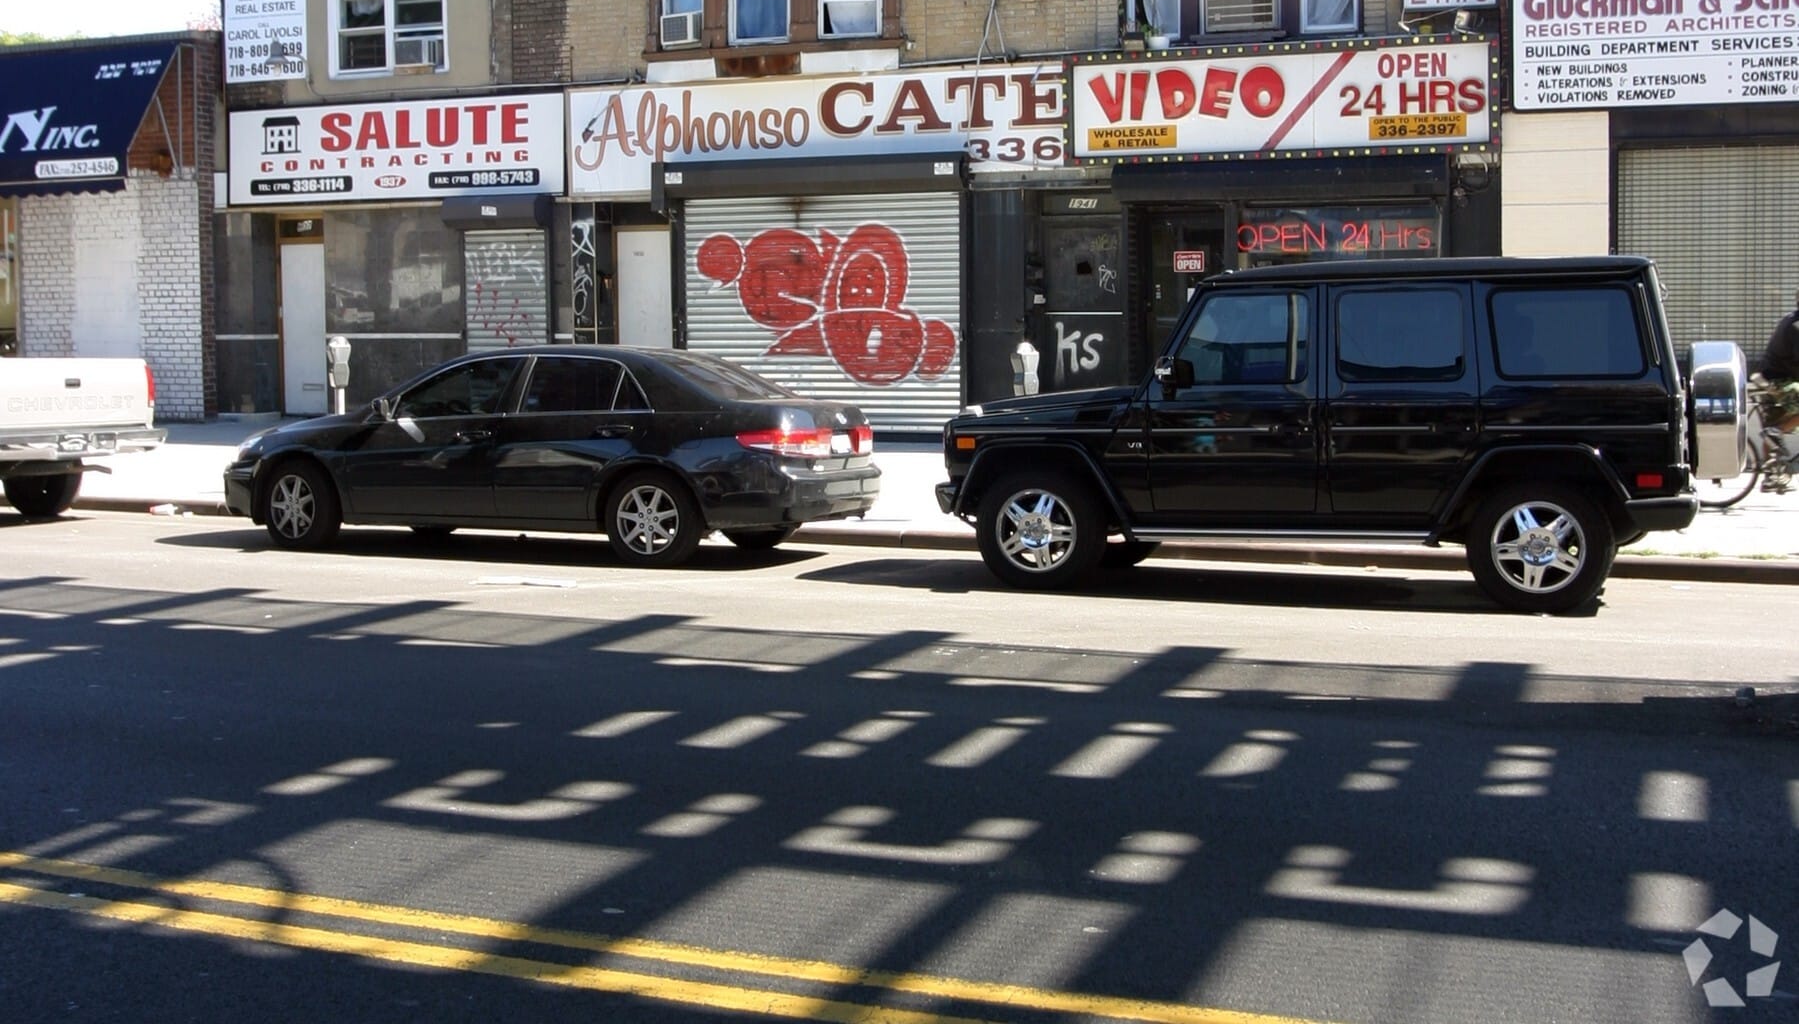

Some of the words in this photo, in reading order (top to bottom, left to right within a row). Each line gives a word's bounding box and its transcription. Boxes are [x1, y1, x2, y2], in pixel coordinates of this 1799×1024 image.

[235, 4, 258, 14] REAL
[262, 1, 296, 12] ESTATE
[228, 29, 261, 41] CAROL
[1525, 20, 1647, 37] REGISTERED
[228, 42, 302, 59] 718-809699
[1525, 44, 1591, 58] BUILDING
[1601, 40, 1700, 55] DEPARTMENT
[230, 60, 304, 78] 718-646-600
[1378, 53, 1447, 79] OPEN
[1537, 65, 1562, 76] NEW
[1569, 63, 1628, 75] BUILDINGS
[1741, 56, 1799, 68] PLANNER
[1538, 77, 1613, 89] ALTERATIONS
[1632, 73, 1707, 86] EXTENSIONS
[1087, 63, 1286, 124] VIDEO
[1340, 83, 1386, 117] 24
[1399, 77, 1486, 115] HRS
[1537, 91, 1608, 103] VIOLATIONS
[1617, 88, 1676, 101] REMOVED
[1742, 84, 1787, 96] ZONING
[320, 103, 529, 153] SALUTE
[575, 90, 810, 171] Alphonso
[1094, 128, 1168, 138] WHOLESALE
[1378, 123, 1456, 137] 336-2397
[1103, 140, 1111, 148] &
[1118, 138, 1159, 148] RETAIL
[261, 150, 528, 173] CONTRACTING
[293, 177, 345, 192] 336-1114
[472, 170, 533, 185] 998-5743
[1236, 222, 1327, 253] OPEN
[1341, 222, 1370, 251] 24
[1177, 259, 1201, 270] OPEN
[7, 394, 135, 413] CHEVROLET
